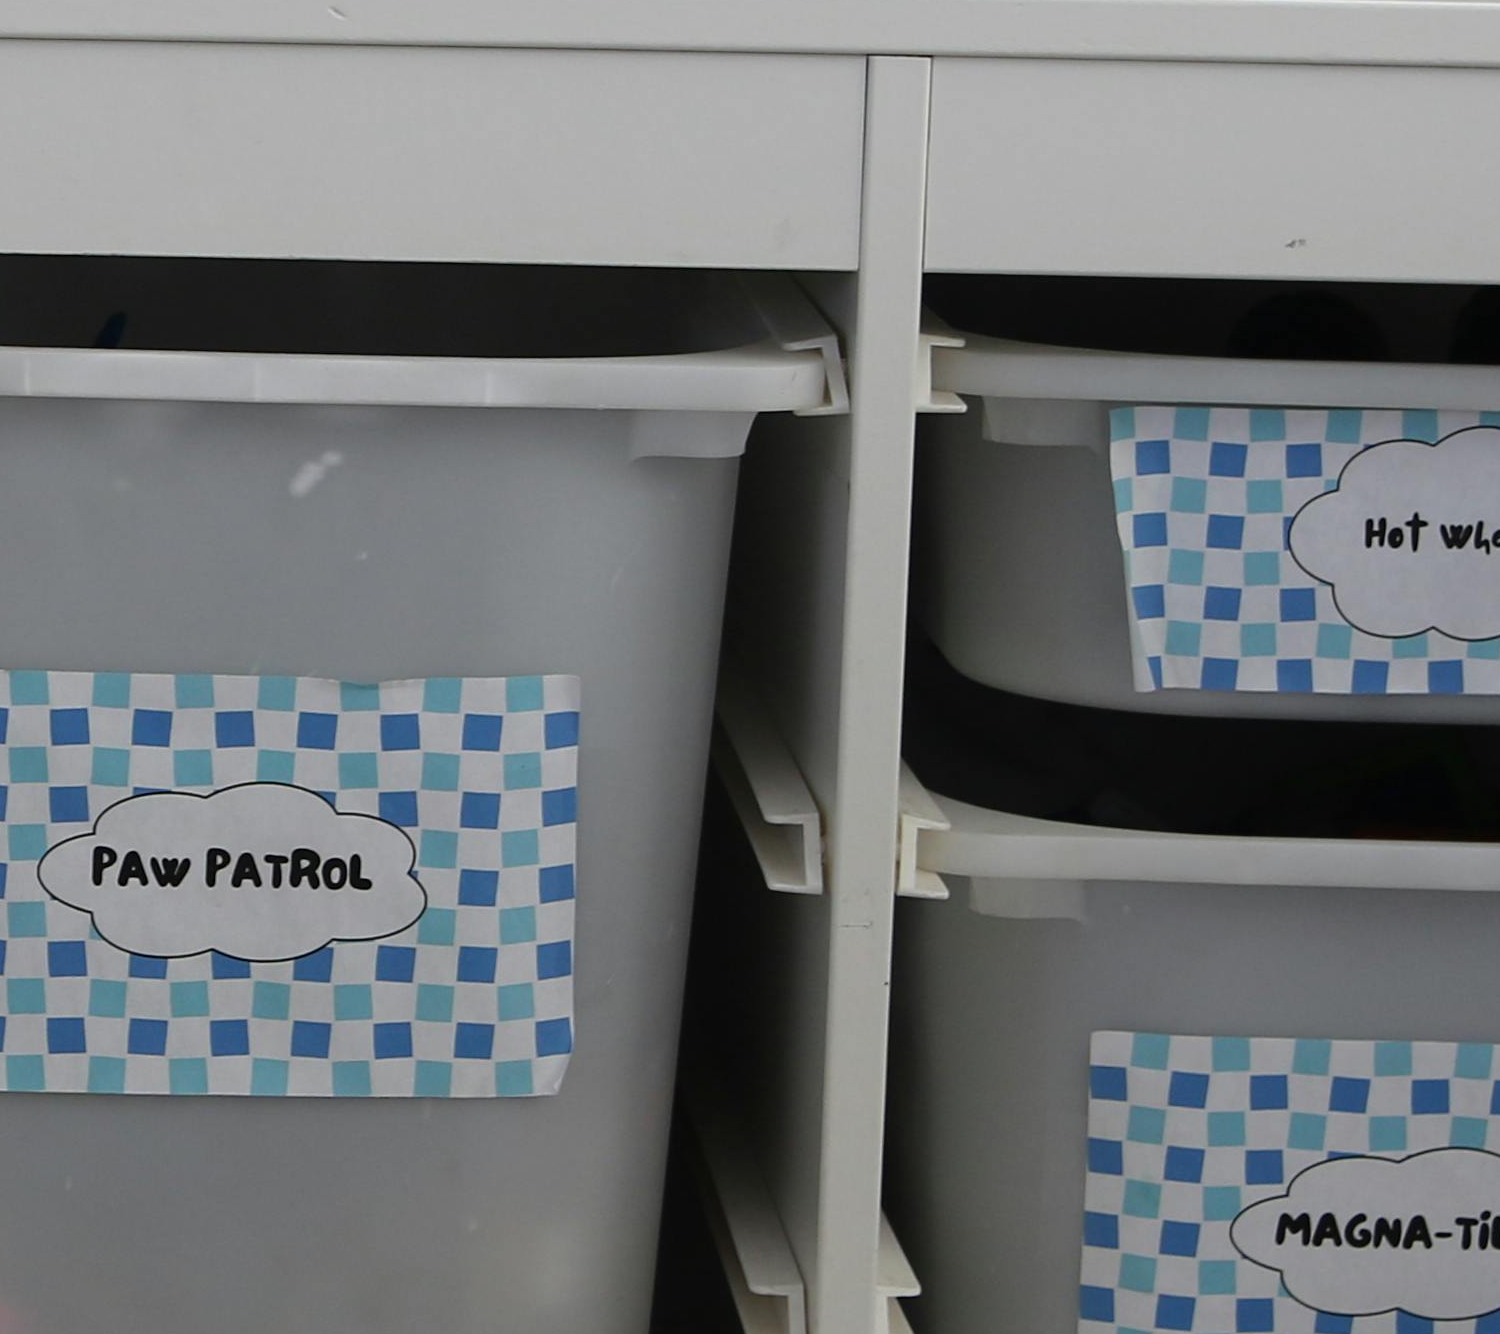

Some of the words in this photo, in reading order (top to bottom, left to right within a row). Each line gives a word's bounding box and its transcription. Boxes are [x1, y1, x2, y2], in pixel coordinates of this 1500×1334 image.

[1365, 512, 1428, 552] Hot
[92, 846, 191, 887] PAW
[206, 848, 372, 890] PATROL
